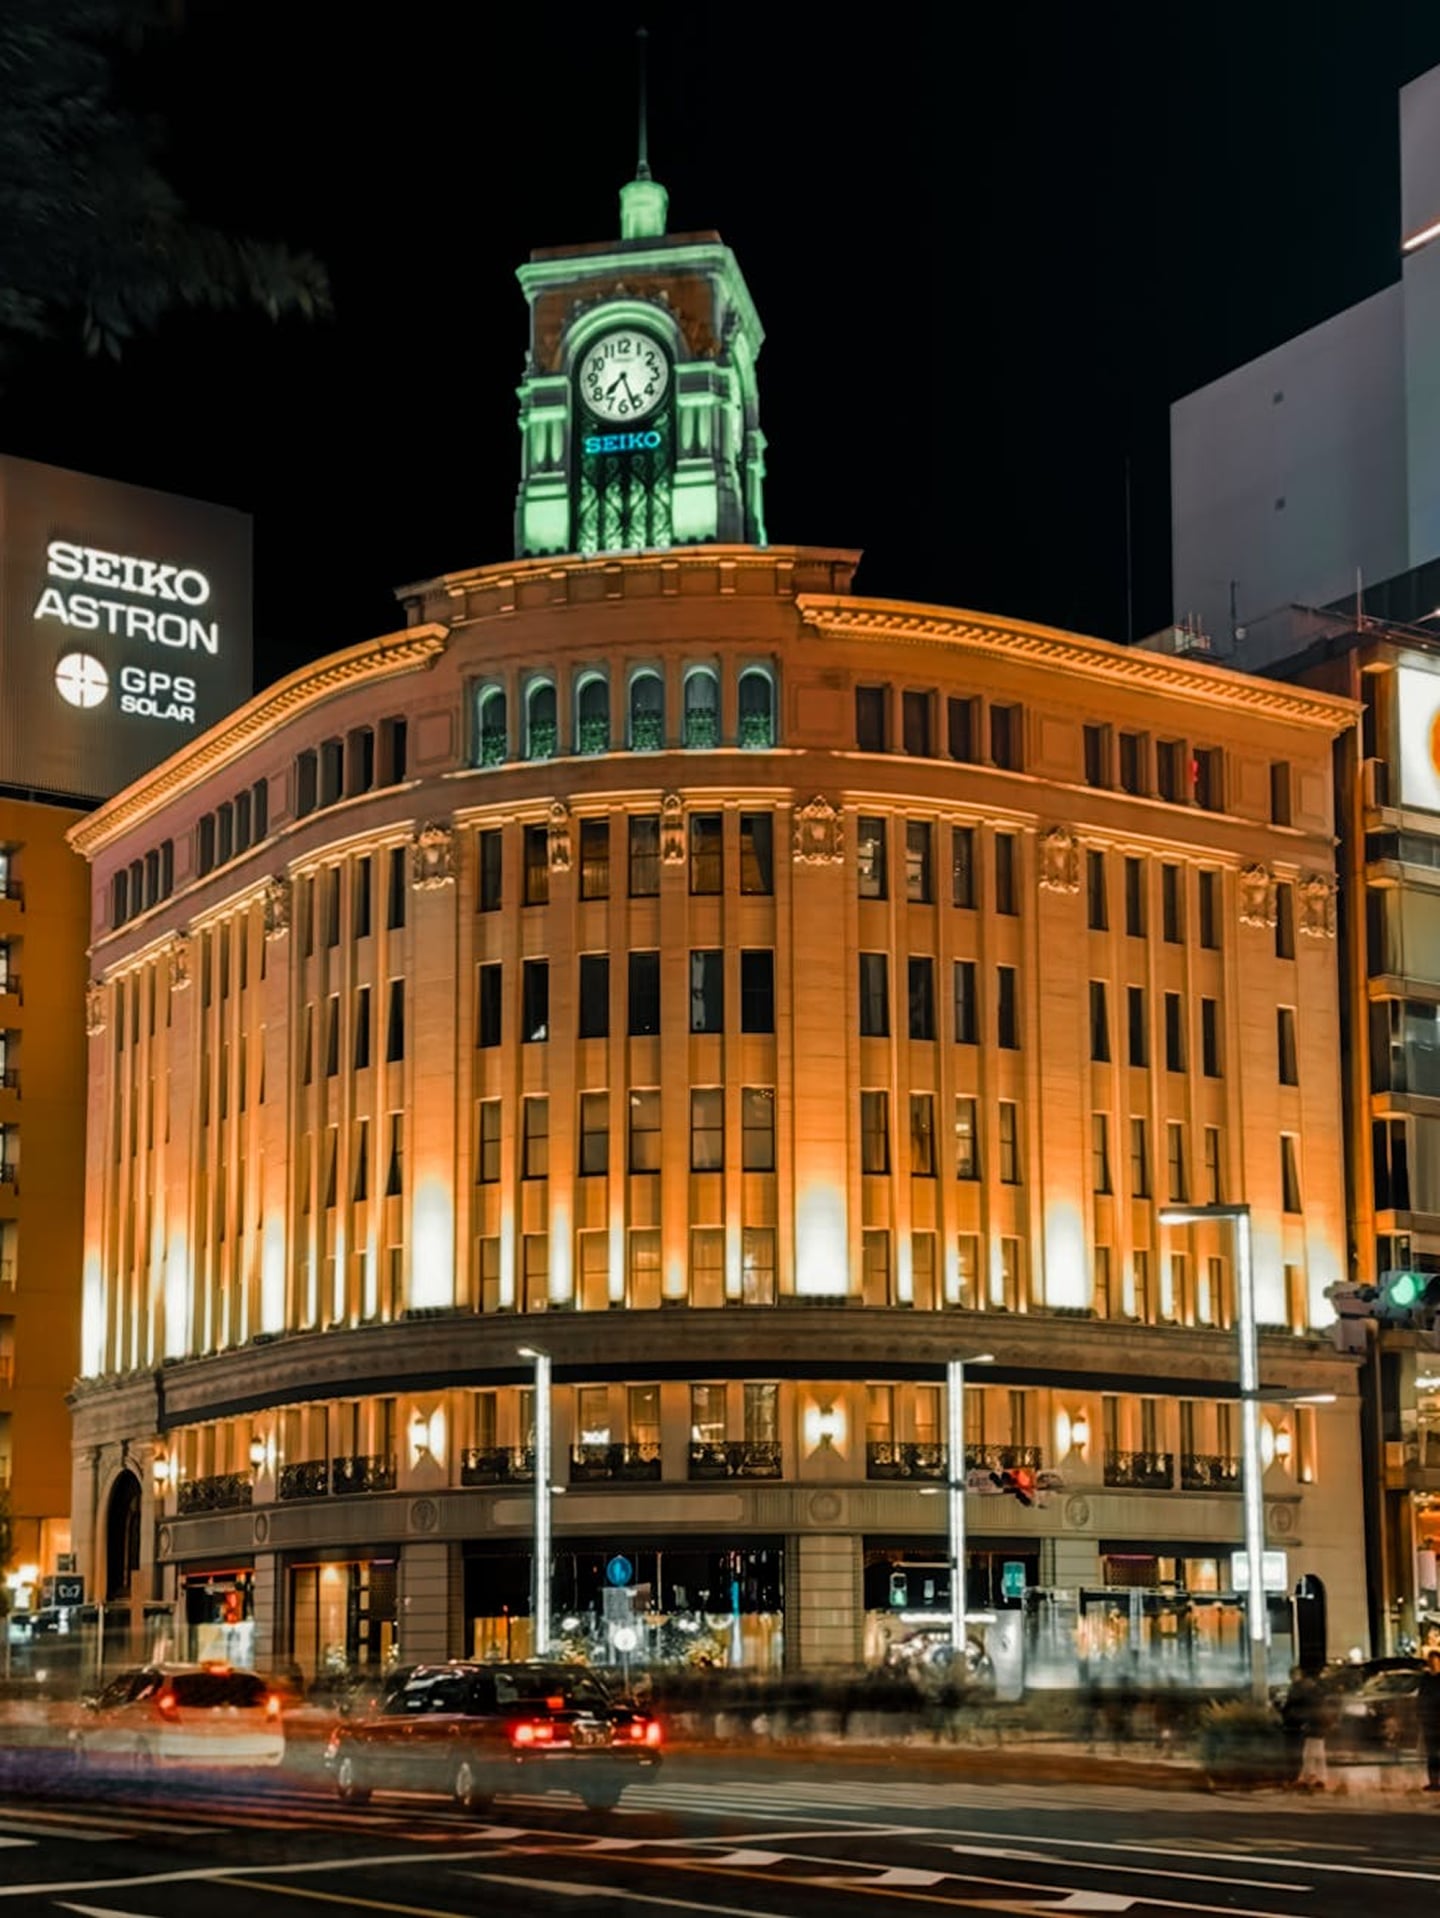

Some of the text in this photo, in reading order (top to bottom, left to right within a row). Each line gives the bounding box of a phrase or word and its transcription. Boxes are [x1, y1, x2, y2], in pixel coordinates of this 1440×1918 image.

[604, 344, 614, 358] 11
[618, 339, 631, 354] 12
[585, 431, 661, 454] SEIKO
[47, 541, 210, 606] SEIKO
[33, 586, 218, 654] ASTRON
[120, 666, 197, 704] GPS
[120, 694, 195, 724] SOLAR
